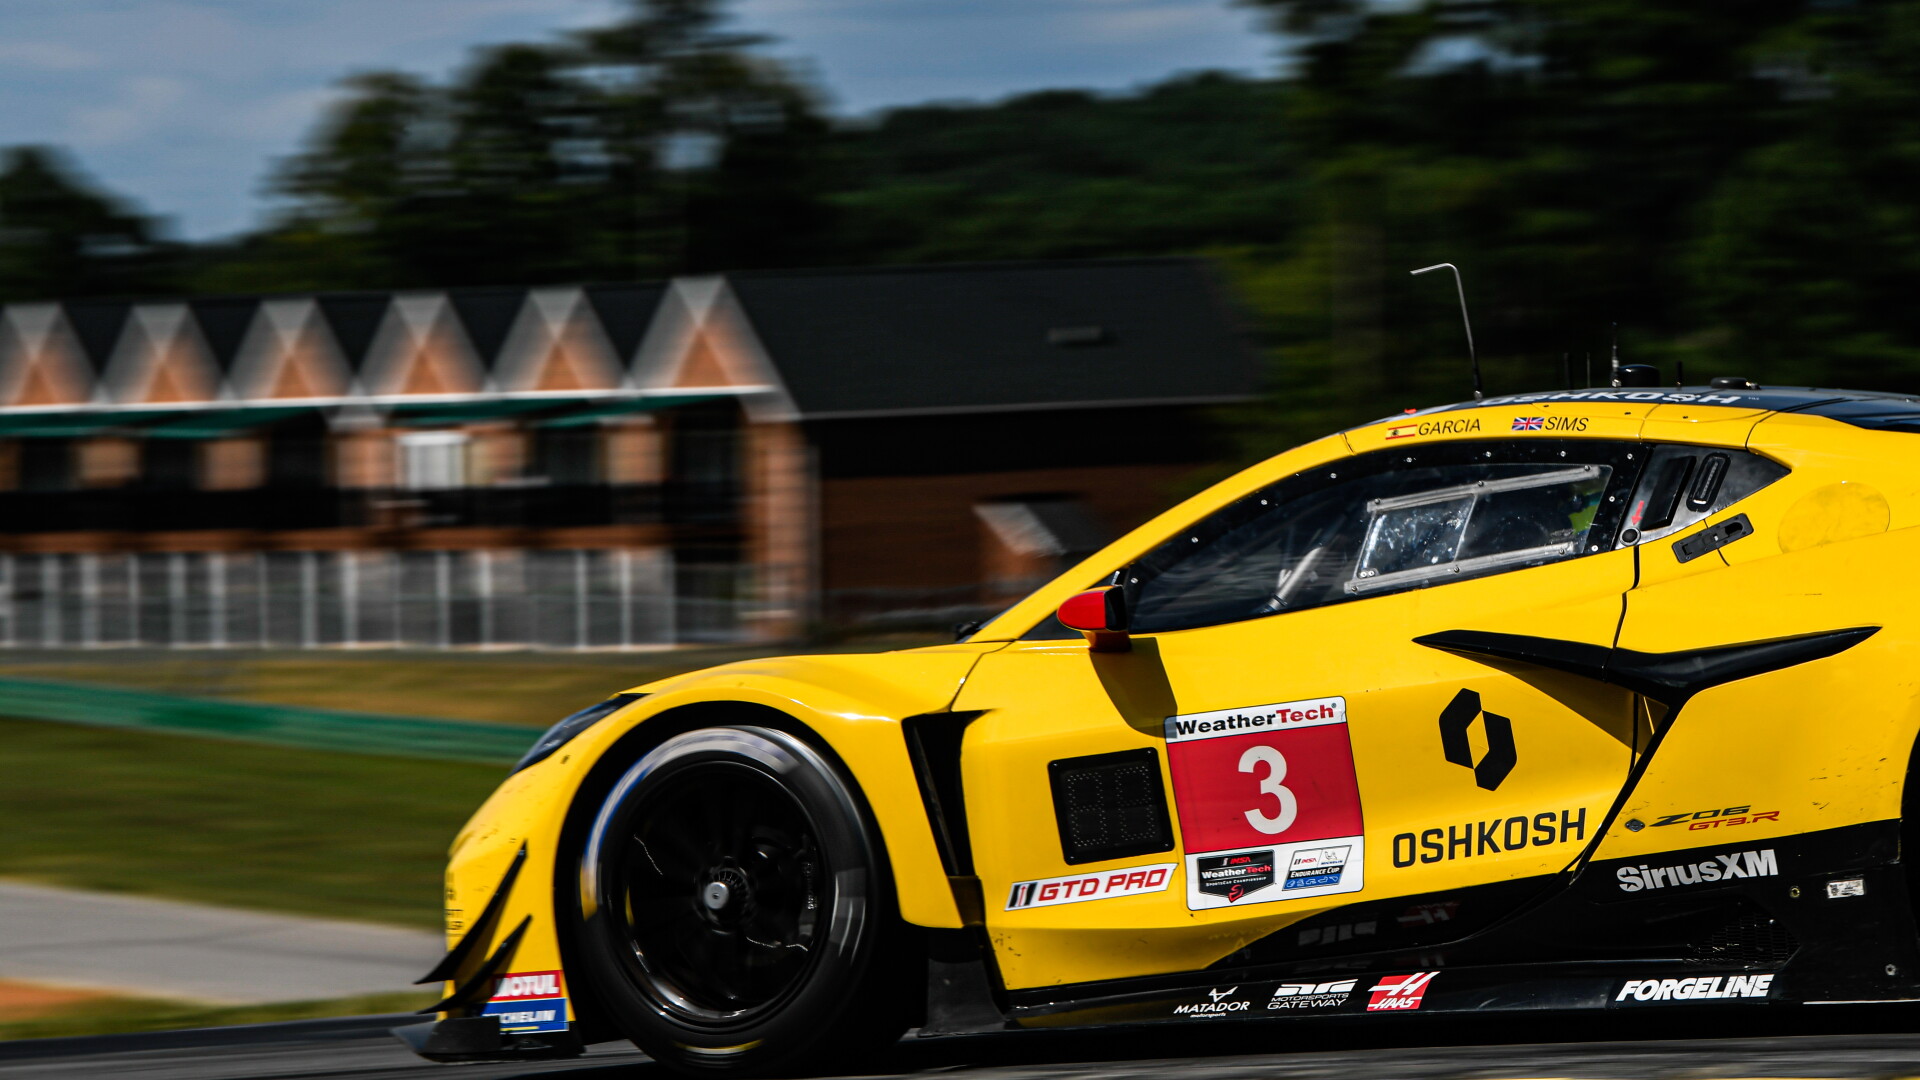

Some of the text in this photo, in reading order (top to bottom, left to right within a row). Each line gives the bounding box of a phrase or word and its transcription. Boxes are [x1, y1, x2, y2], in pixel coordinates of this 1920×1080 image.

[1418, 418, 1481, 436] GARCIA
[1545, 416, 1589, 432] SIMS
[1238, 745, 1298, 835] 3
[1688, 811, 1780, 831] GT3.R
[1392, 807, 1587, 869] OSHKOSH
[1291, 868, 1326, 878] ENDURANCE
[1616, 849, 1779, 892] SiriusXM
[1038, 868, 1168, 902] GTD PRO
[494, 974, 560, 997] MOTUL
[1615, 974, 1775, 1002] FORGELINE
[1267, 998, 1347, 1010] GATEWAY
[1271, 992, 1350, 1002] MOTORSPORTS
[1372, 997, 1419, 1009] HAAS
[1173, 1001, 1251, 1014] MATADOR
